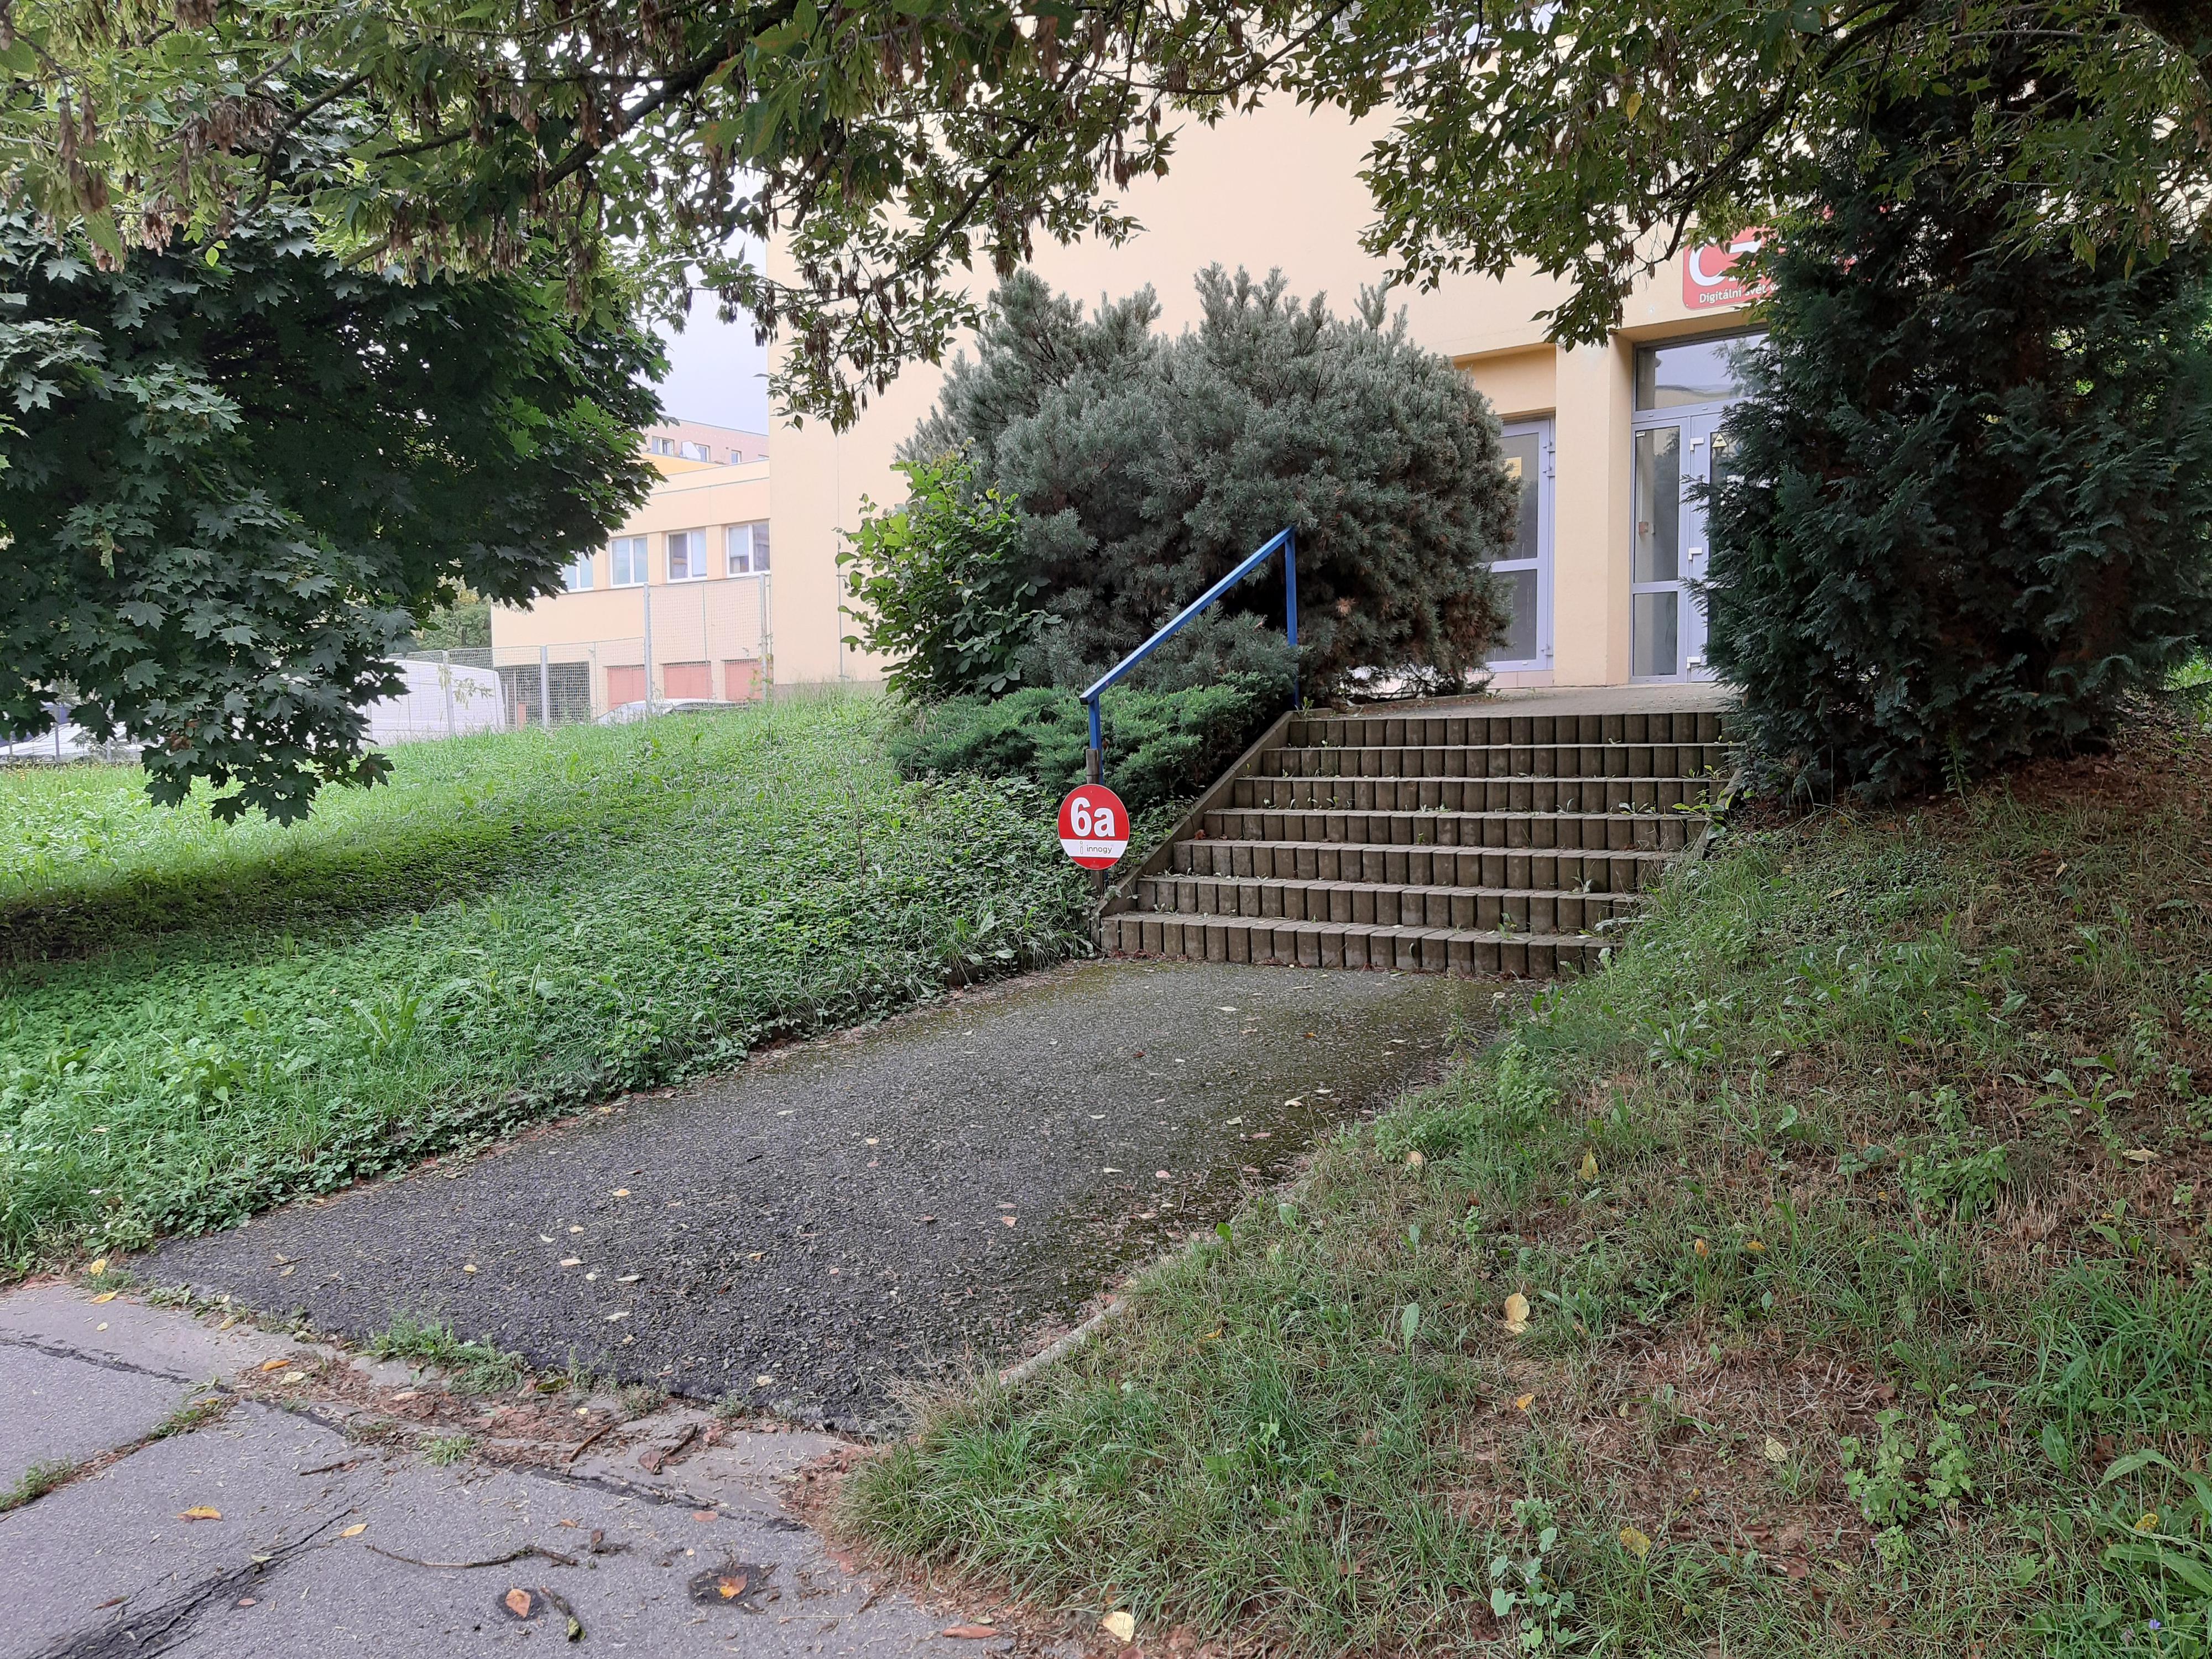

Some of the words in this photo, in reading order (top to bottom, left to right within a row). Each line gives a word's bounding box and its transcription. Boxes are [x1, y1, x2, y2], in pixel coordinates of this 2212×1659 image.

[1699, 286, 1741, 304] Digitální
[1071, 797, 1115, 837] 6a
[1086, 844, 1112, 854] innogy
